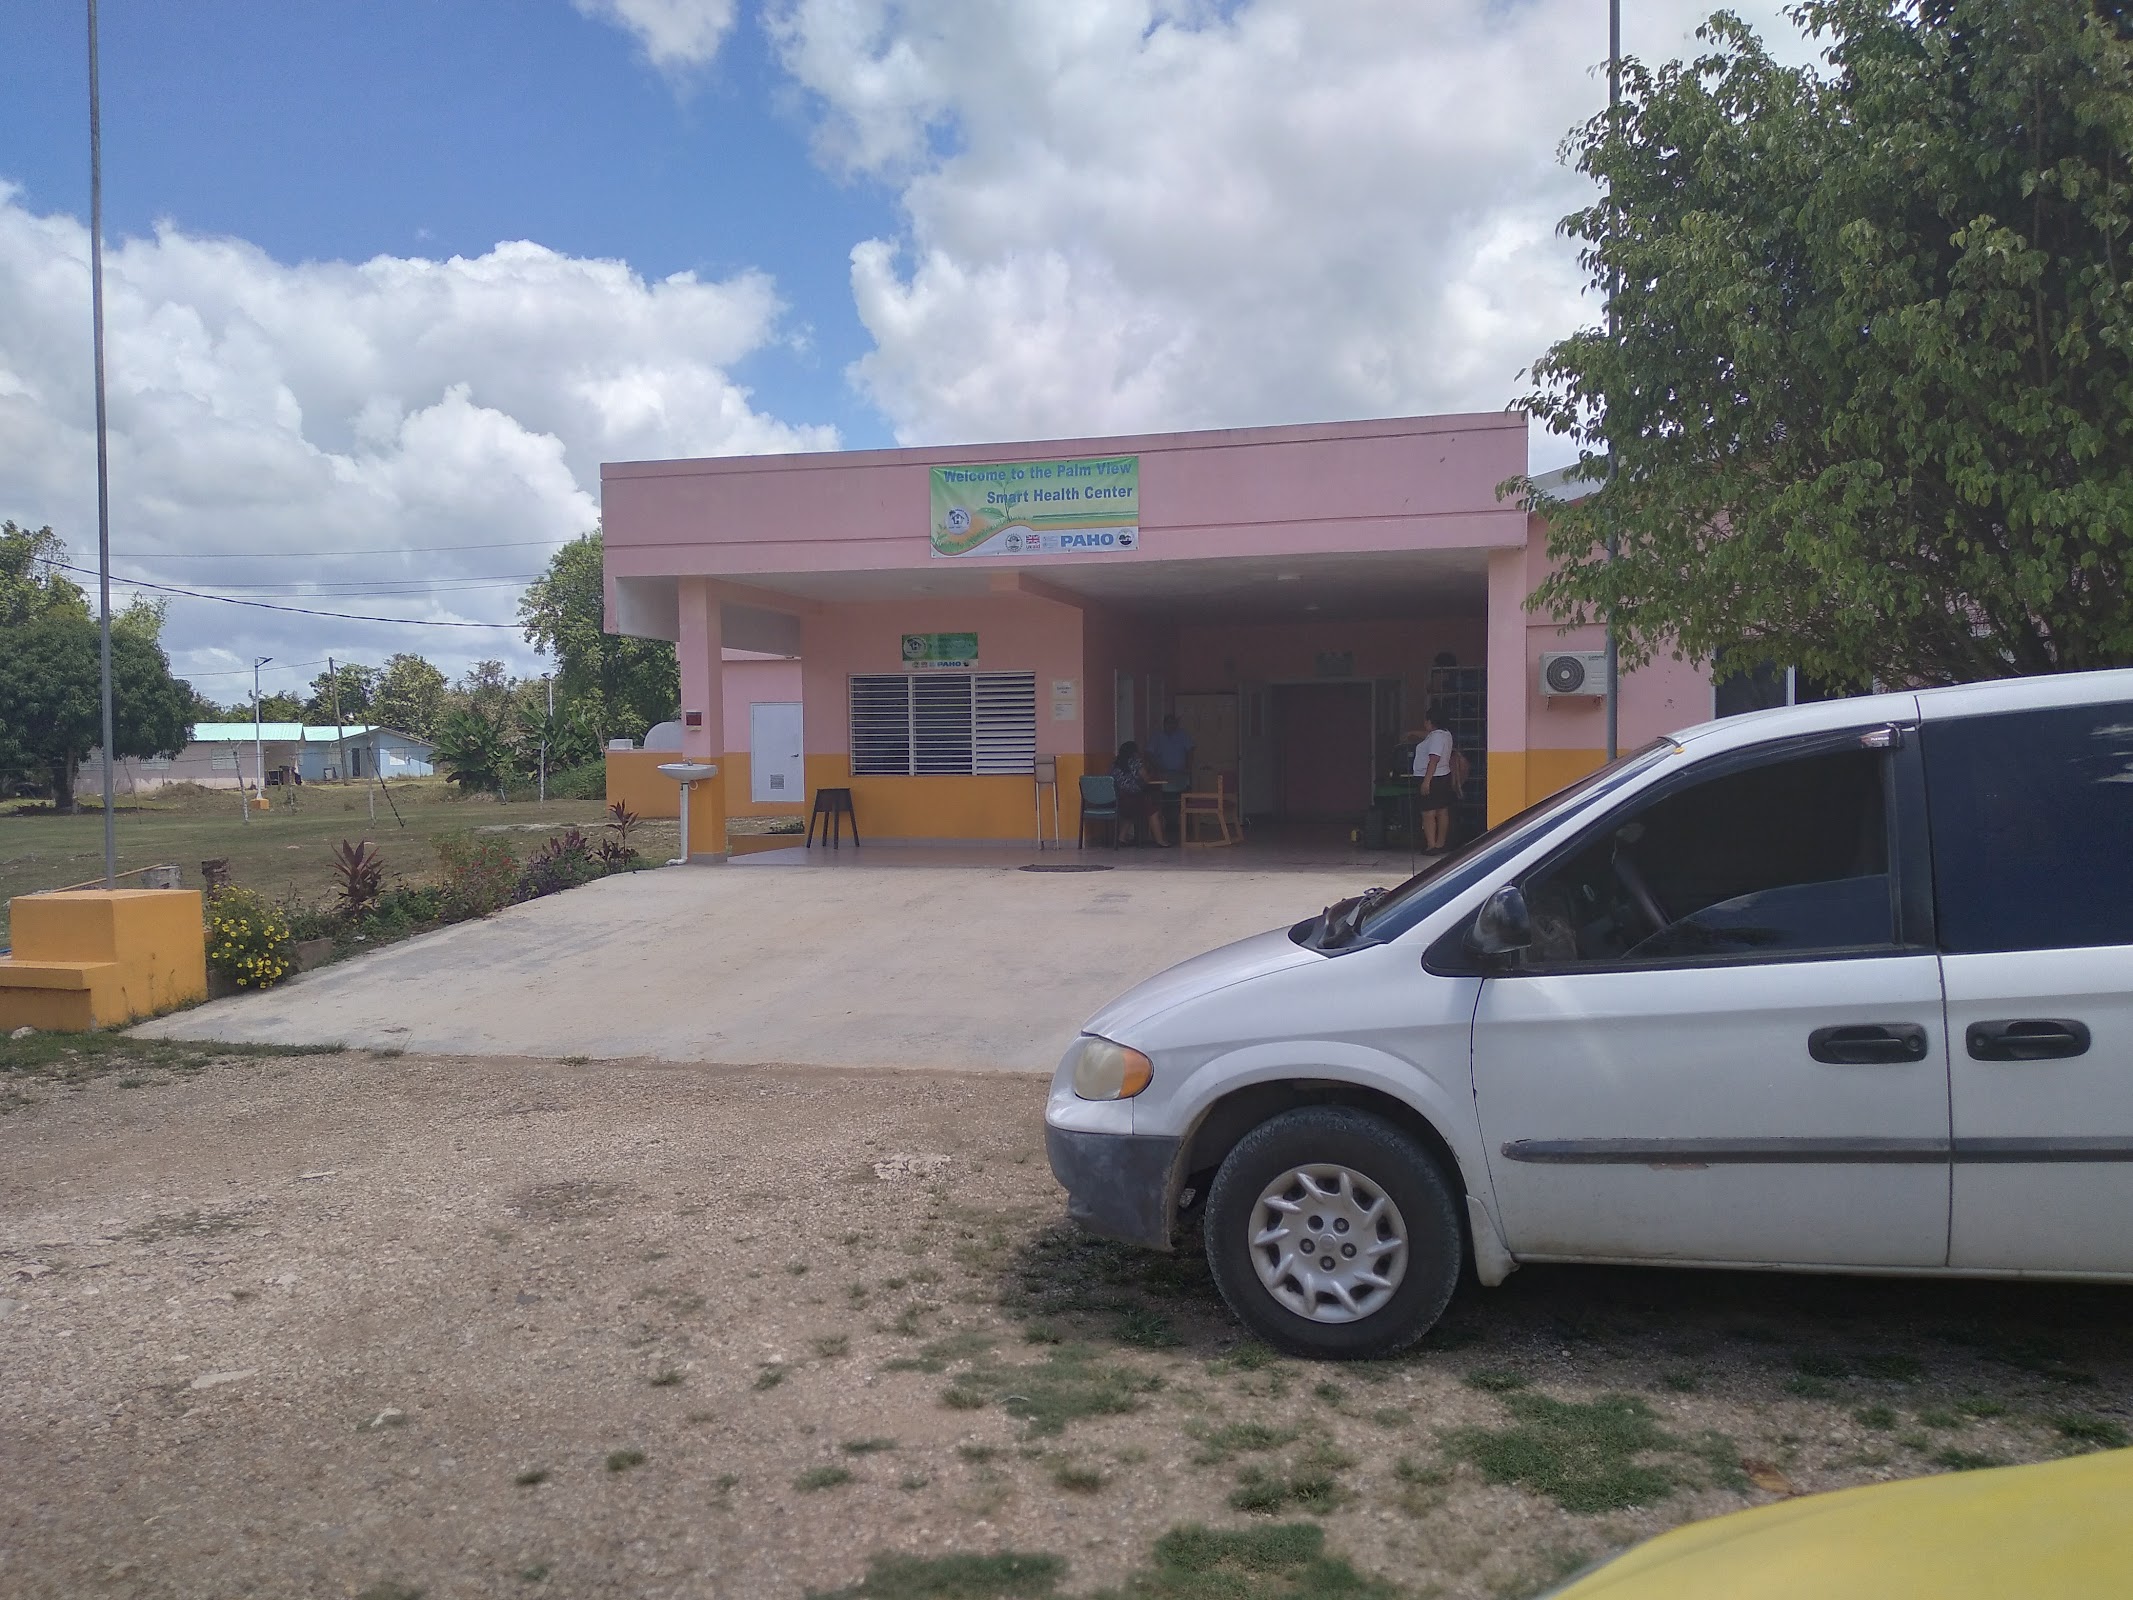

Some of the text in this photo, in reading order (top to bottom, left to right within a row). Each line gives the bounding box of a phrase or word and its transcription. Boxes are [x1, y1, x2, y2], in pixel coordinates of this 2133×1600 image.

[944, 462, 1131, 482] Welcome to the Palm View
[987, 485, 1133, 504] Smart Health Center
[1060, 533, 1115, 547] PAHO
